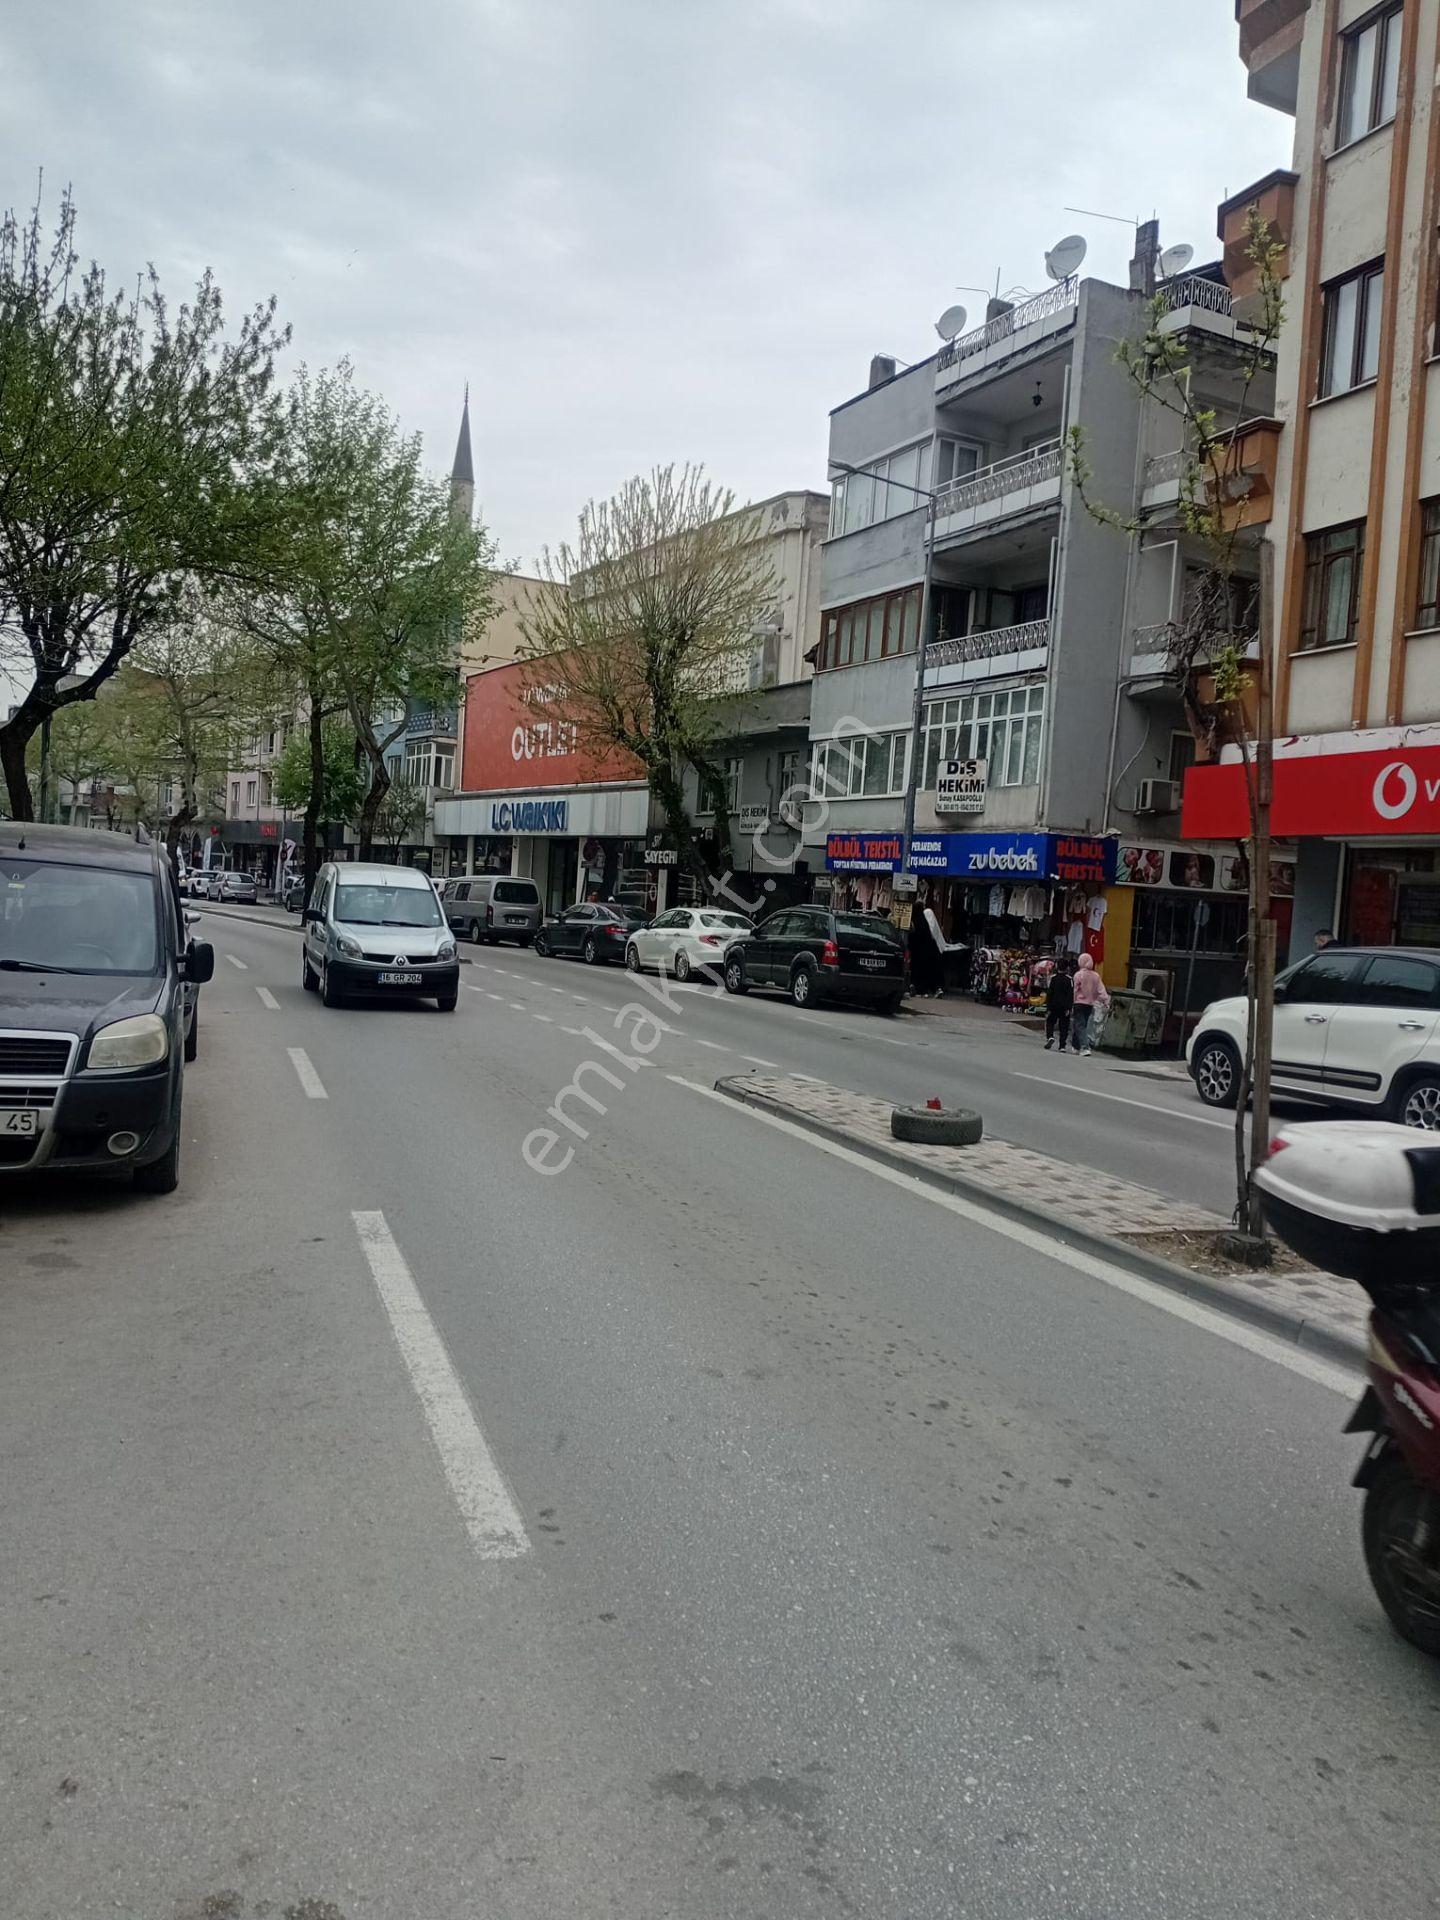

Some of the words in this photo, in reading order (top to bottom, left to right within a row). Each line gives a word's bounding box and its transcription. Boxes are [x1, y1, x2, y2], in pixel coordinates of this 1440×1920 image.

[511, 719, 580, 761] OUTLET
[491, 802, 512, 831] LC
[828, 836, 861, 858] BÜLBÜL
[864, 836, 901, 859] TEKSTİL
[1056, 837, 1105, 859] BÜLBÜL
[6, 1114, 32, 1131] 45
